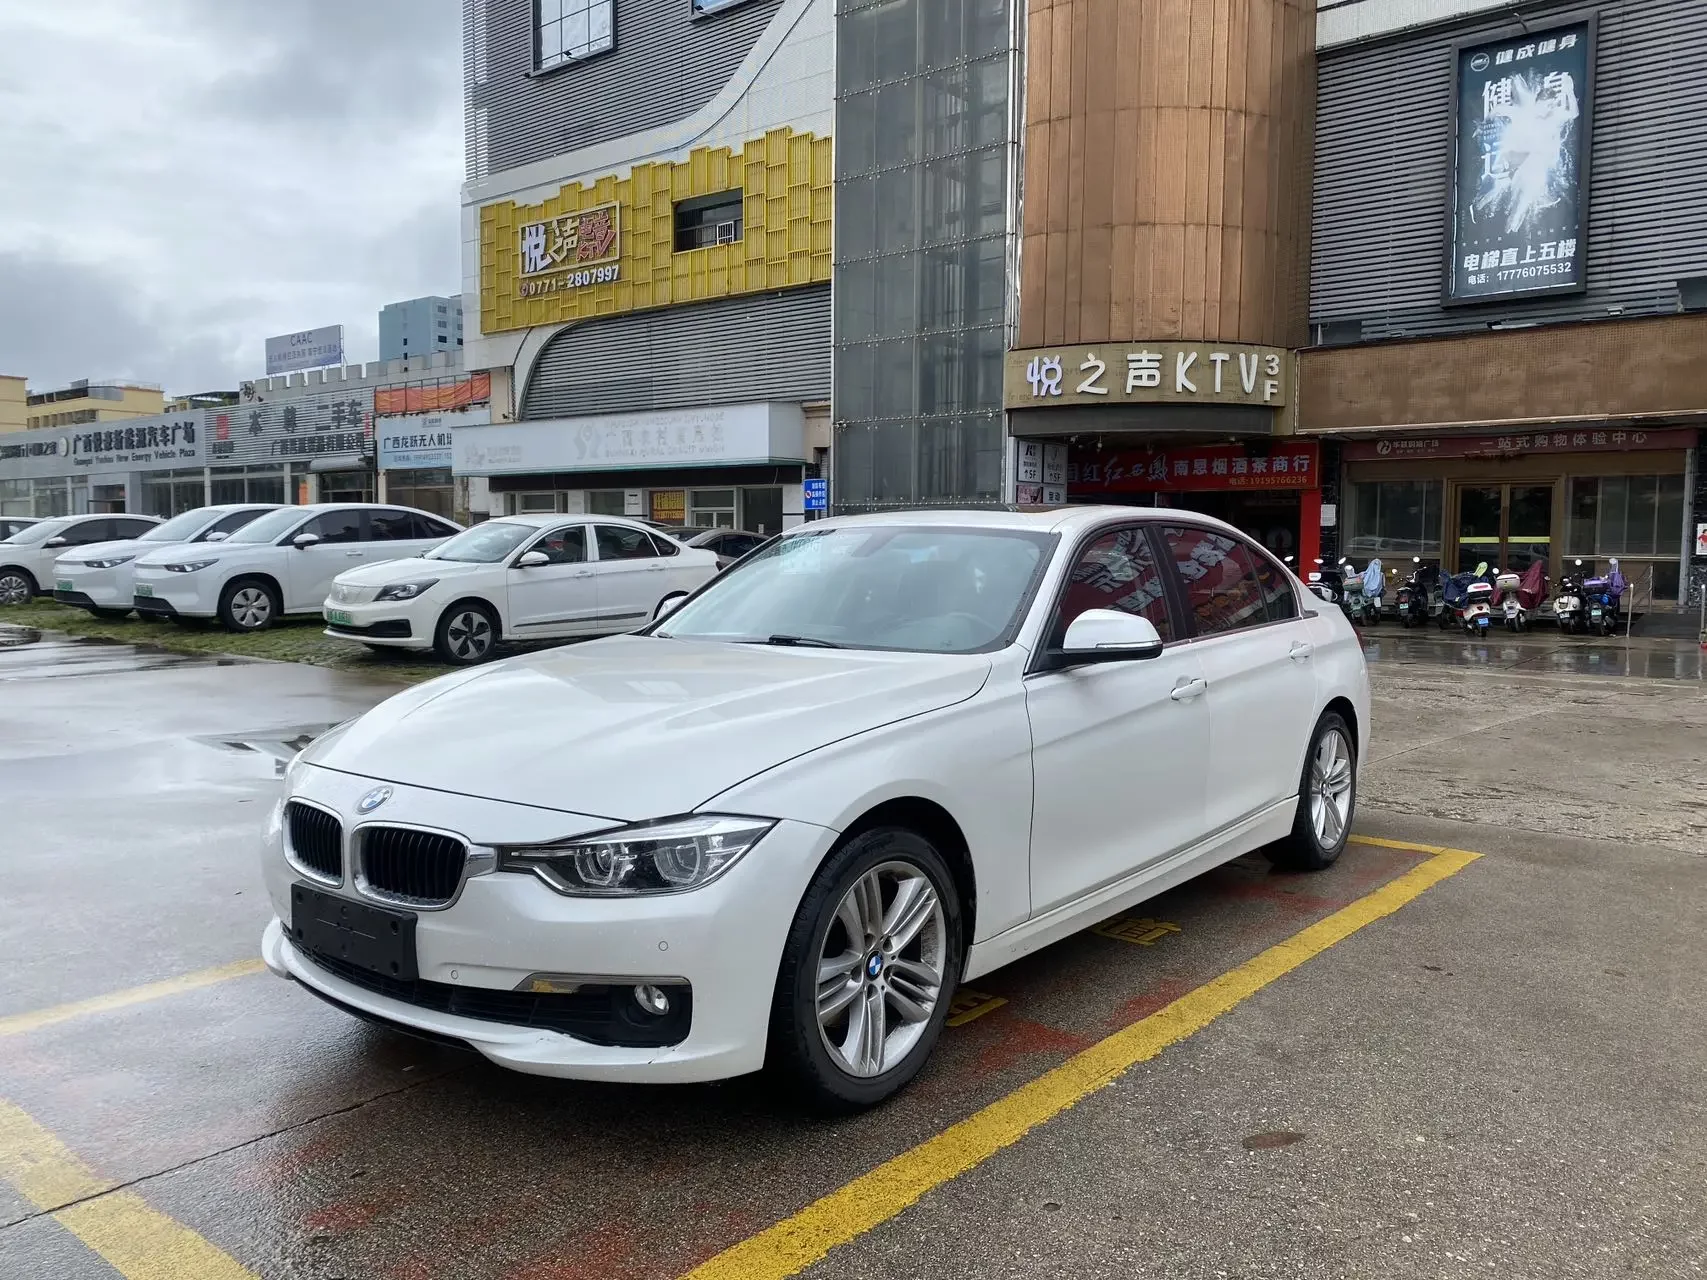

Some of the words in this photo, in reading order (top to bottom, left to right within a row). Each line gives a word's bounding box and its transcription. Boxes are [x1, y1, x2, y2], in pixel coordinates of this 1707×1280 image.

[1495, 34, 1578, 65] 健成健身
[576, 229, 616, 262] KTV
[1464, 239, 1577, 271] 电梯直上五楼
[529, 264, 619, 295] 0771-2807997
[1497, 262, 1572, 281] 17776075532
[290, 332, 313, 347] CAAC
[73, 421, 195, 454] 广西新能源汽车广场
[1479, 431, 1648, 449] 一站式购物体验中心
[131, 452, 152, 462] Energy
[154, 450, 176, 459] Vehicle
[179, 448, 195, 458] Plaza
